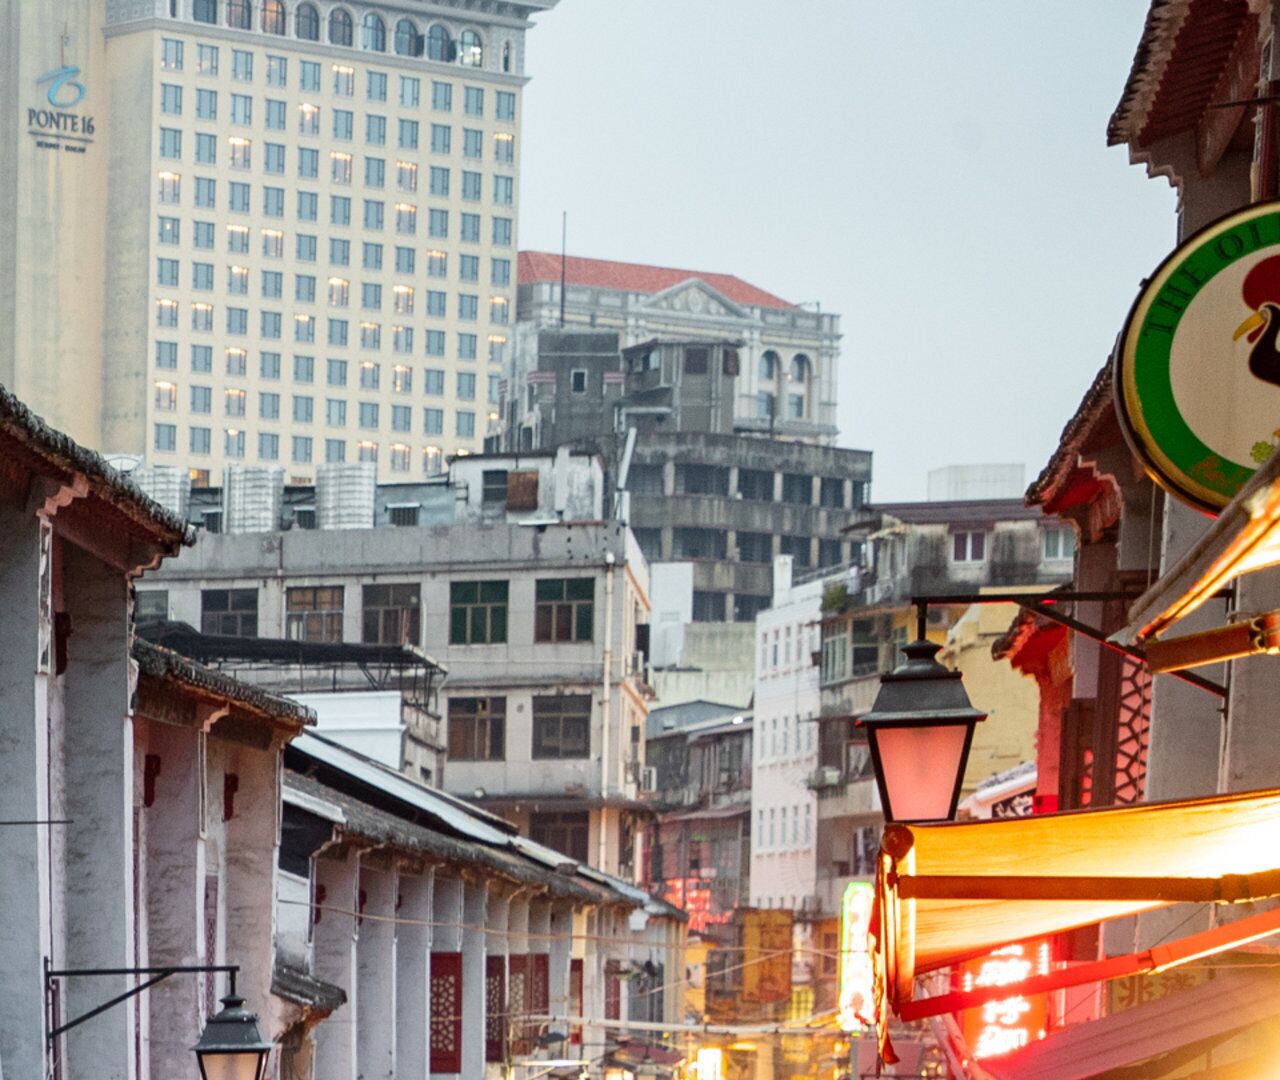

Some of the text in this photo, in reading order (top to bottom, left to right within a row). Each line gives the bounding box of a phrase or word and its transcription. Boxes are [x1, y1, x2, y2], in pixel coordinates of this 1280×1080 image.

[28, 108, 95, 135] PONTE 16
[1144, 216, 1280, 338] THE OL
